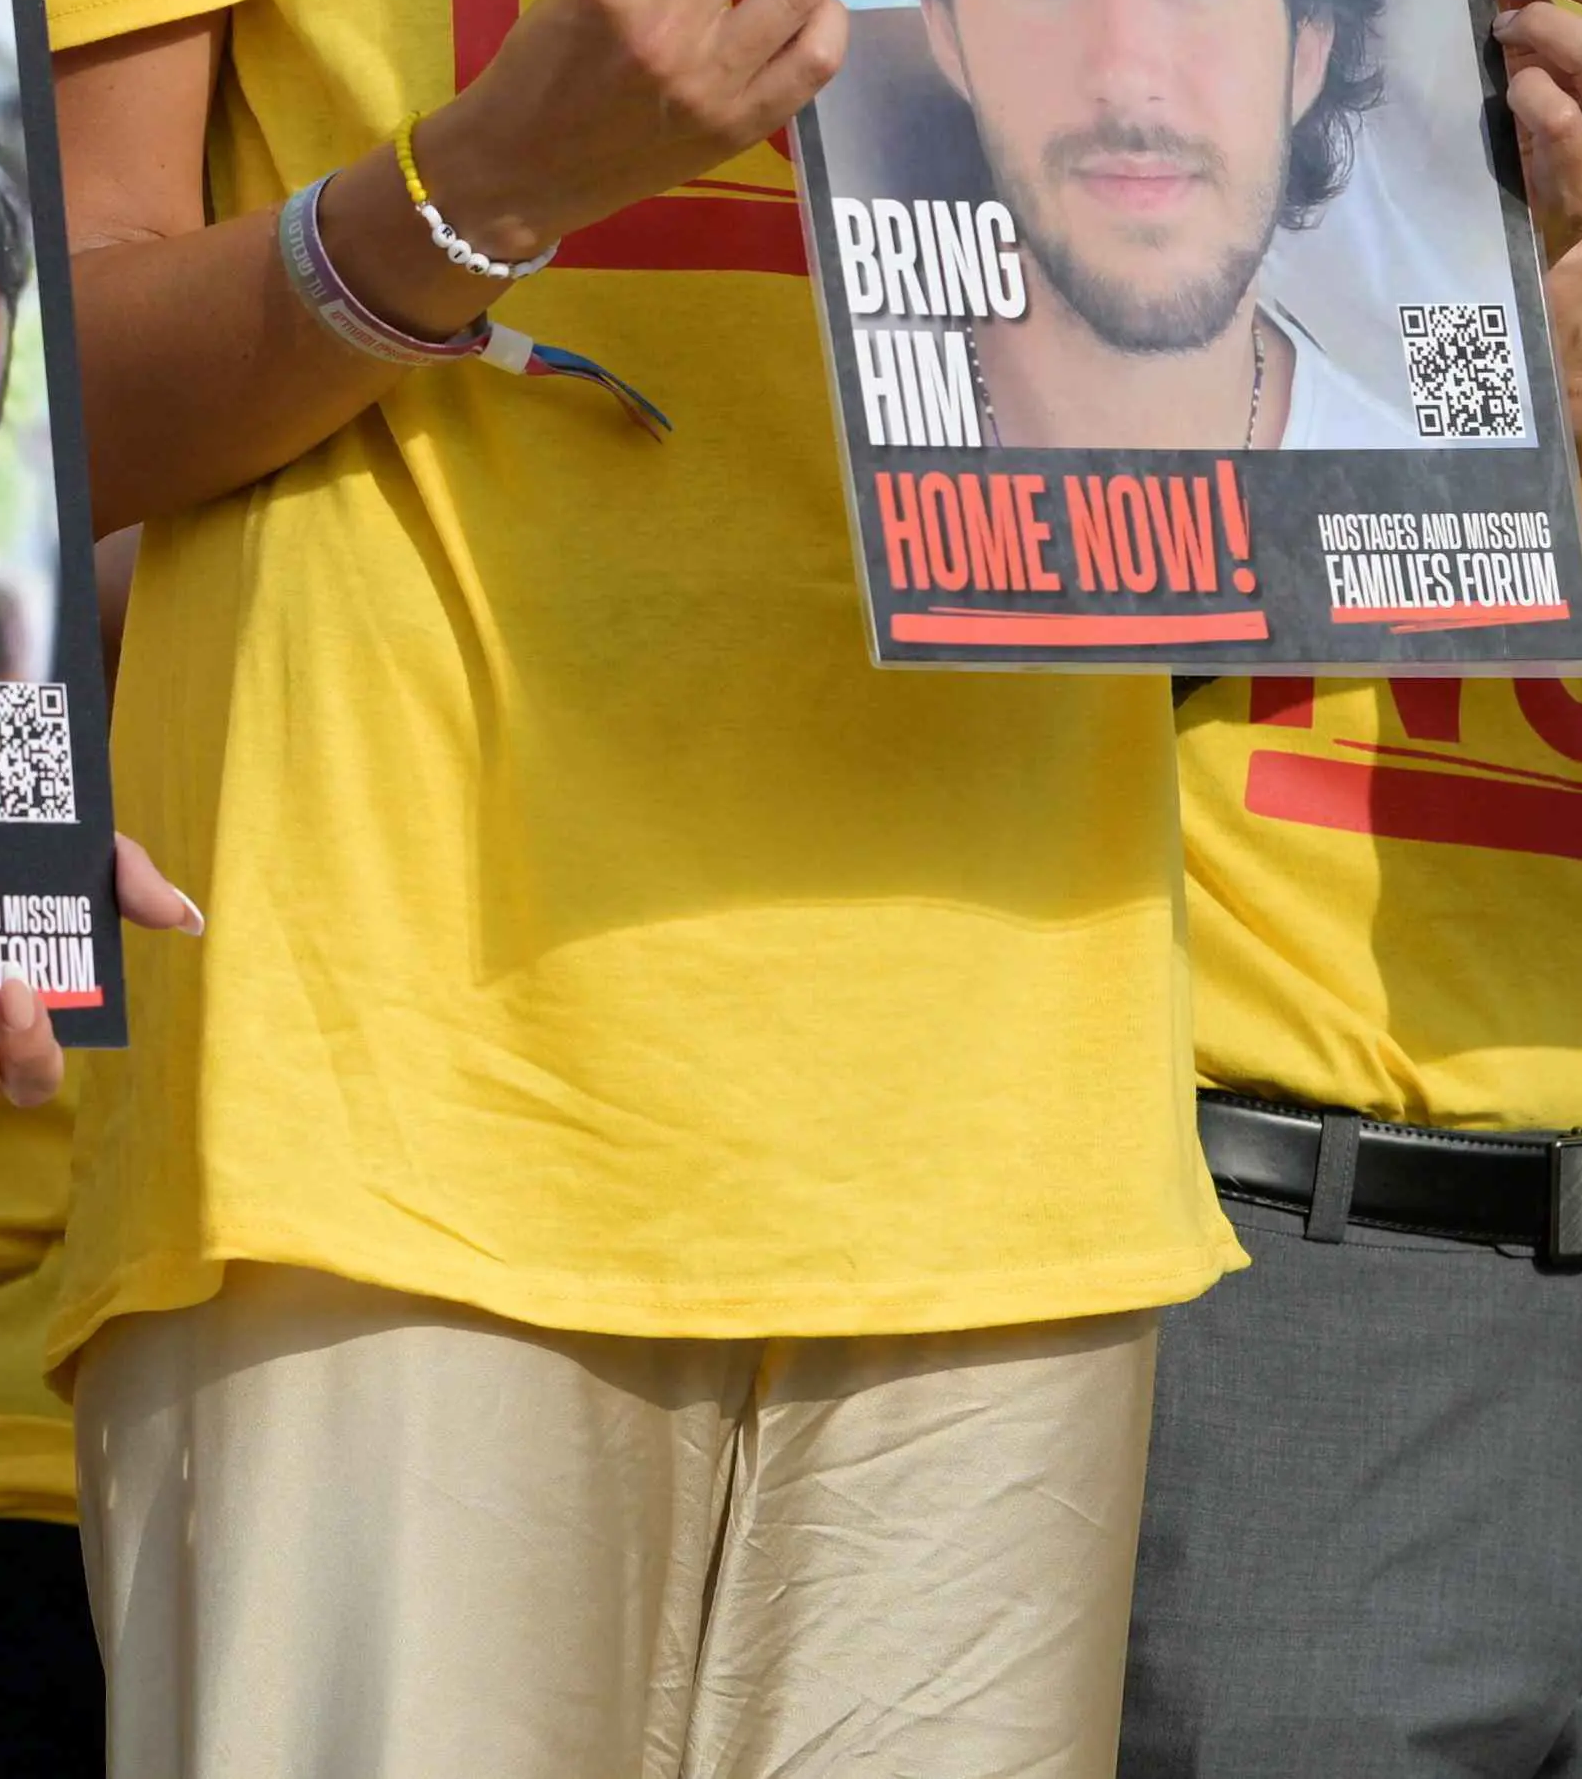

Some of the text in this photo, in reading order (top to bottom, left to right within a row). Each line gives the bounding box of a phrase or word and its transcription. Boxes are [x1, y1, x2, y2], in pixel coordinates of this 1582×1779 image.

[833, 196, 1027, 320] BRING
[852, 329, 982, 447] HIM
[874, 458, 1256, 594] HOME NOW!
[1318, 511, 1552, 551] HOSTAGES AND MISSING
[1325, 552, 1562, 609] FAMILIES FORUM
[4, 895, 92, 935] MISSING
